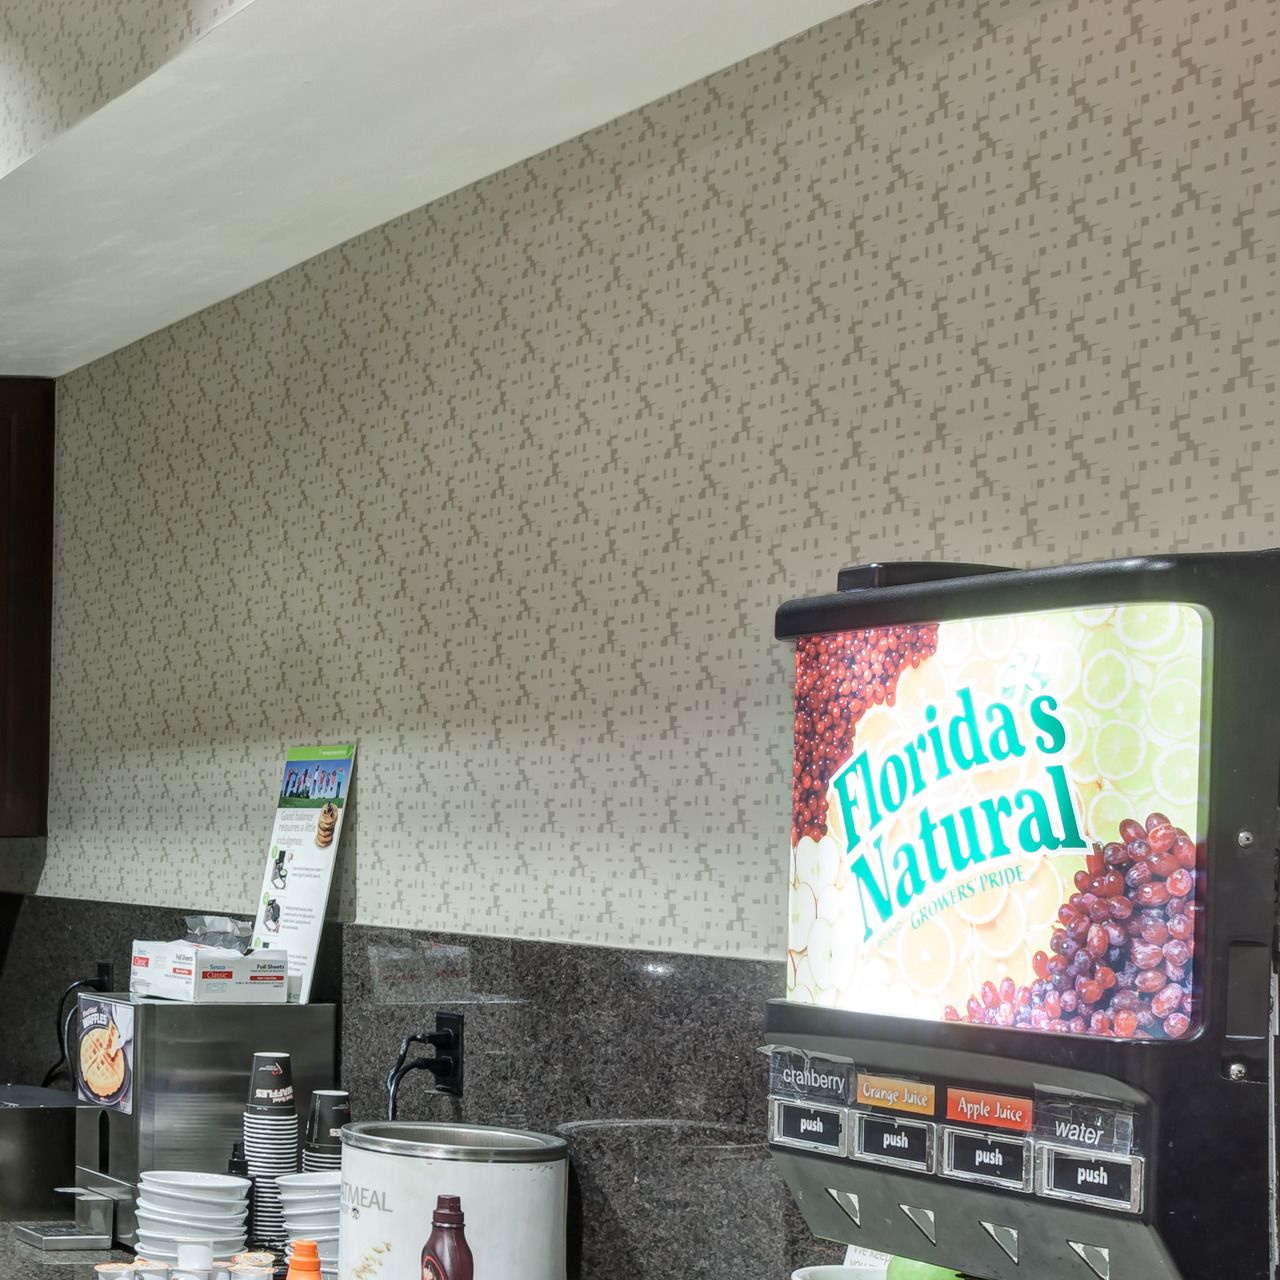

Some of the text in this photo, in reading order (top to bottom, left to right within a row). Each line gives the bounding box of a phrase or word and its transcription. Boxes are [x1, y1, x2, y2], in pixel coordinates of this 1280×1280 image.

[850, 765, 1088, 944] Natural
[979, 864, 1025, 892] PRIDE
[783, 1068, 845, 1094] cranberry
[863, 1082, 928, 1106] Orange Juice
[957, 1097, 1023, 1122] Apple Juice
[800, 1117, 823, 1133] push
[1055, 1120, 1104, 1145] water
[883, 1131, 909, 1148] push
[975, 1148, 1003, 1166] push
[1077, 1167, 1108, 1185] push
